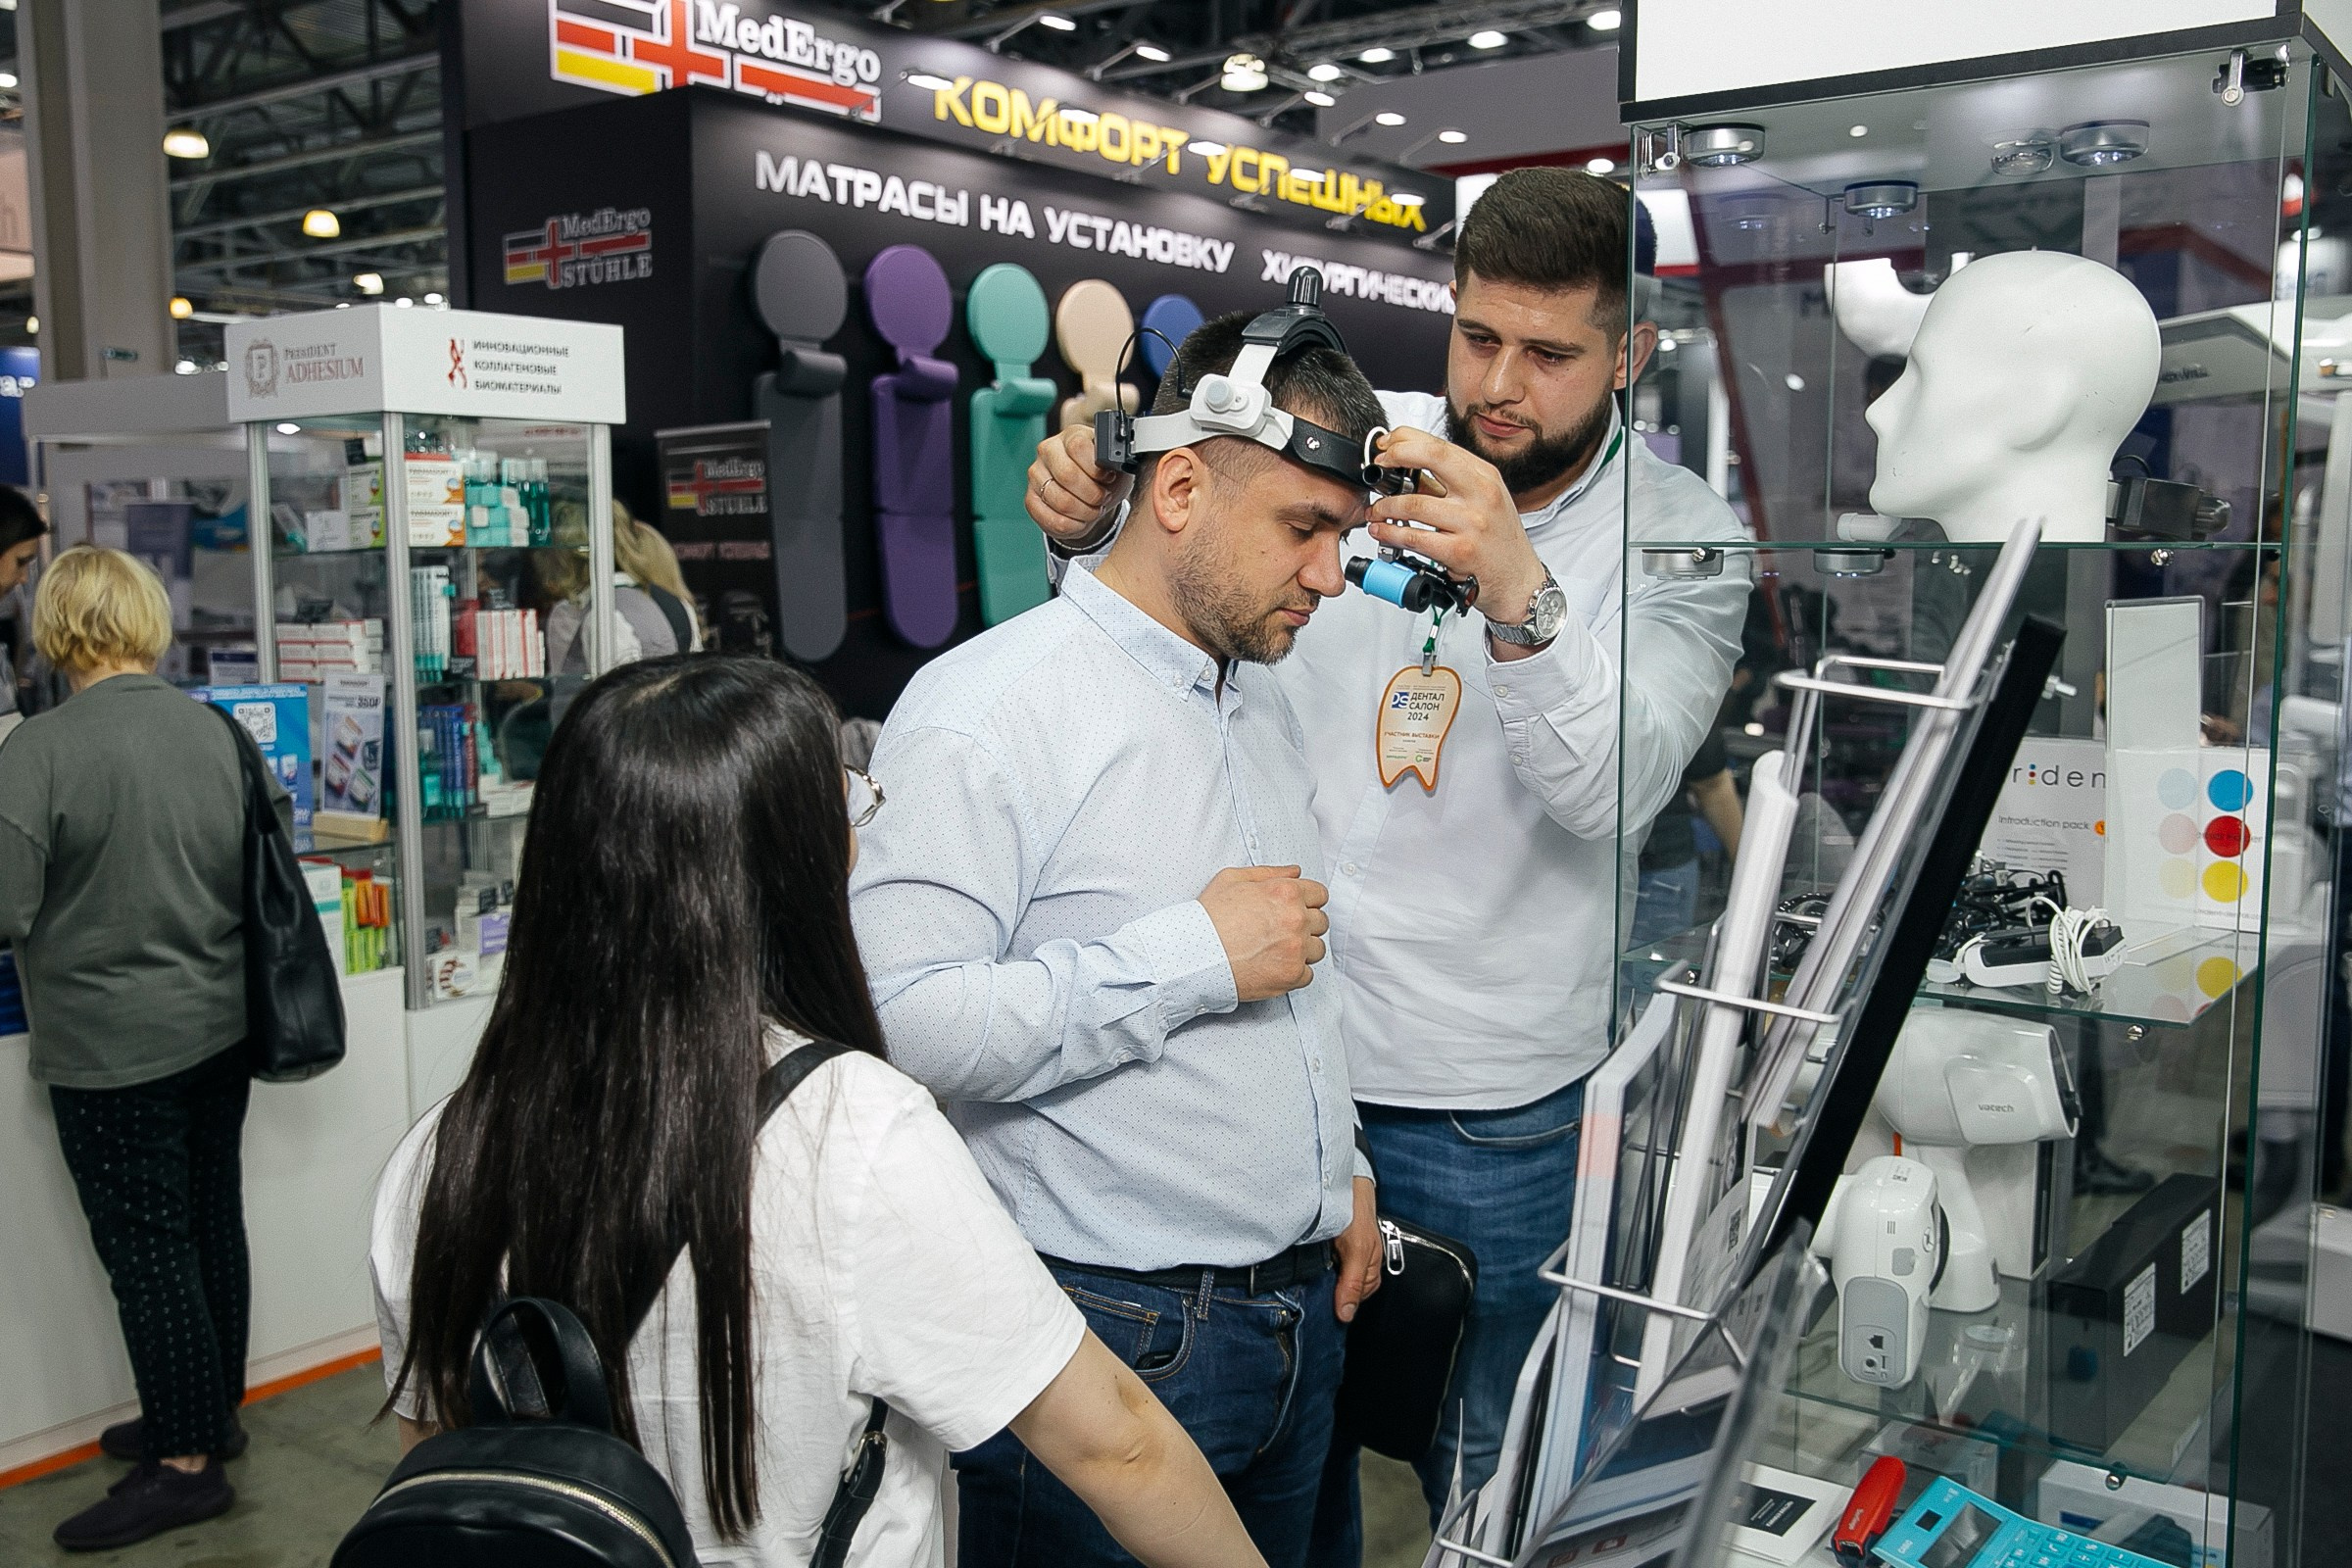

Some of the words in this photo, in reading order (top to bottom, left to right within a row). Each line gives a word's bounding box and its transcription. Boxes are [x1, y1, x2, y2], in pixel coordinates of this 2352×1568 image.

[695, 0, 882, 87] MedErgo
[934, 75, 1191, 175] КОМФОРТ
[755, 150, 969, 226] МАТРАСЫ
[980, 193, 1036, 239] НА
[1043, 206, 1236, 273] УСТАНОВКУ
[562, 208, 652, 238] MedErgo
[473, 340, 569, 358] ИННОВАЦИОННЫЕ
[285, 357, 366, 384] ADHESIUM
[474, 360, 558, 375] КОЛЛАГЕНОВЫЕ
[475, 379, 563, 394] БИОМАТЕРИАЛЫ
[1410, 692, 1446, 702] ДЕНТАЛ
[1408, 702, 1441, 711] САЛОН
[1407, 711, 1430, 721] 2024
